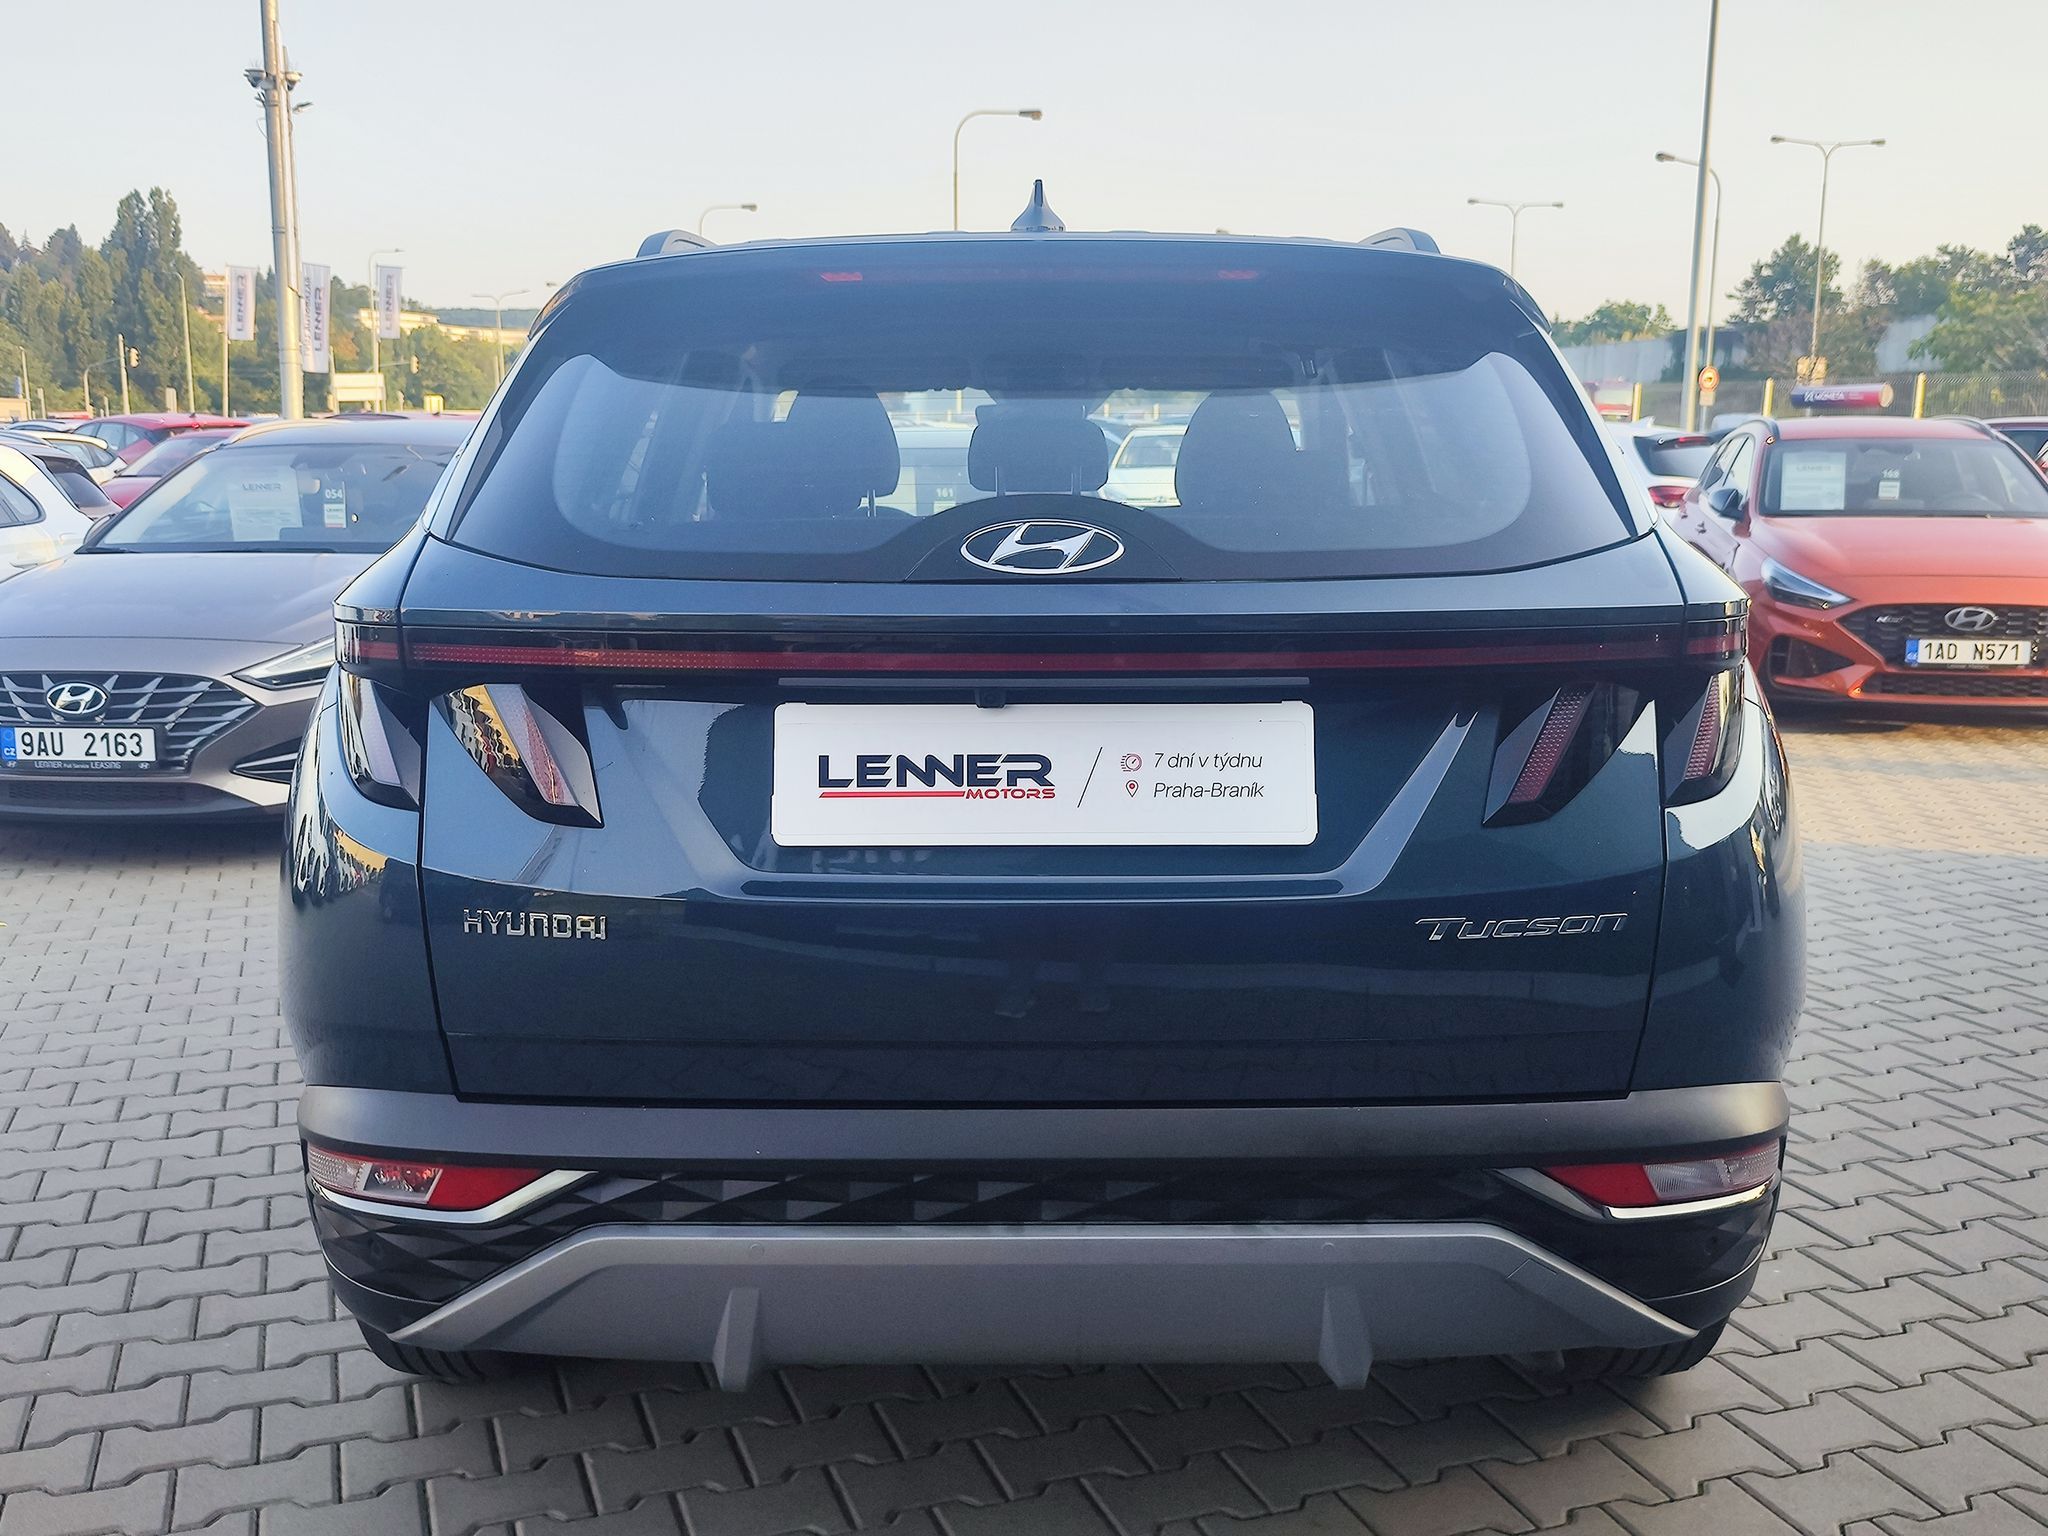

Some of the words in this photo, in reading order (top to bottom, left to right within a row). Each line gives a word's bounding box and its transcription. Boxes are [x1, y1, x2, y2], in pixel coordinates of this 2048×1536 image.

[325, 488, 343, 499] 054
[1924, 642, 1958, 660] 1AD
[1973, 643, 2020, 661] N571
[4, 747, 17, 757] CZ
[20, 731, 63, 757] 9AU
[84, 732, 143, 758] 2163
[817, 752, 1053, 789] LENNER
[1154, 753, 1164, 768] 7
[1167, 752, 1194, 769] dní
[1197, 758, 1207, 769] v
[1211, 752, 1263, 773] týdnu
[964, 788, 1056, 800] MOTORS
[1153, 781, 1265, 799] Praha-Braník
[463, 908, 607, 941] HYUNDAI
